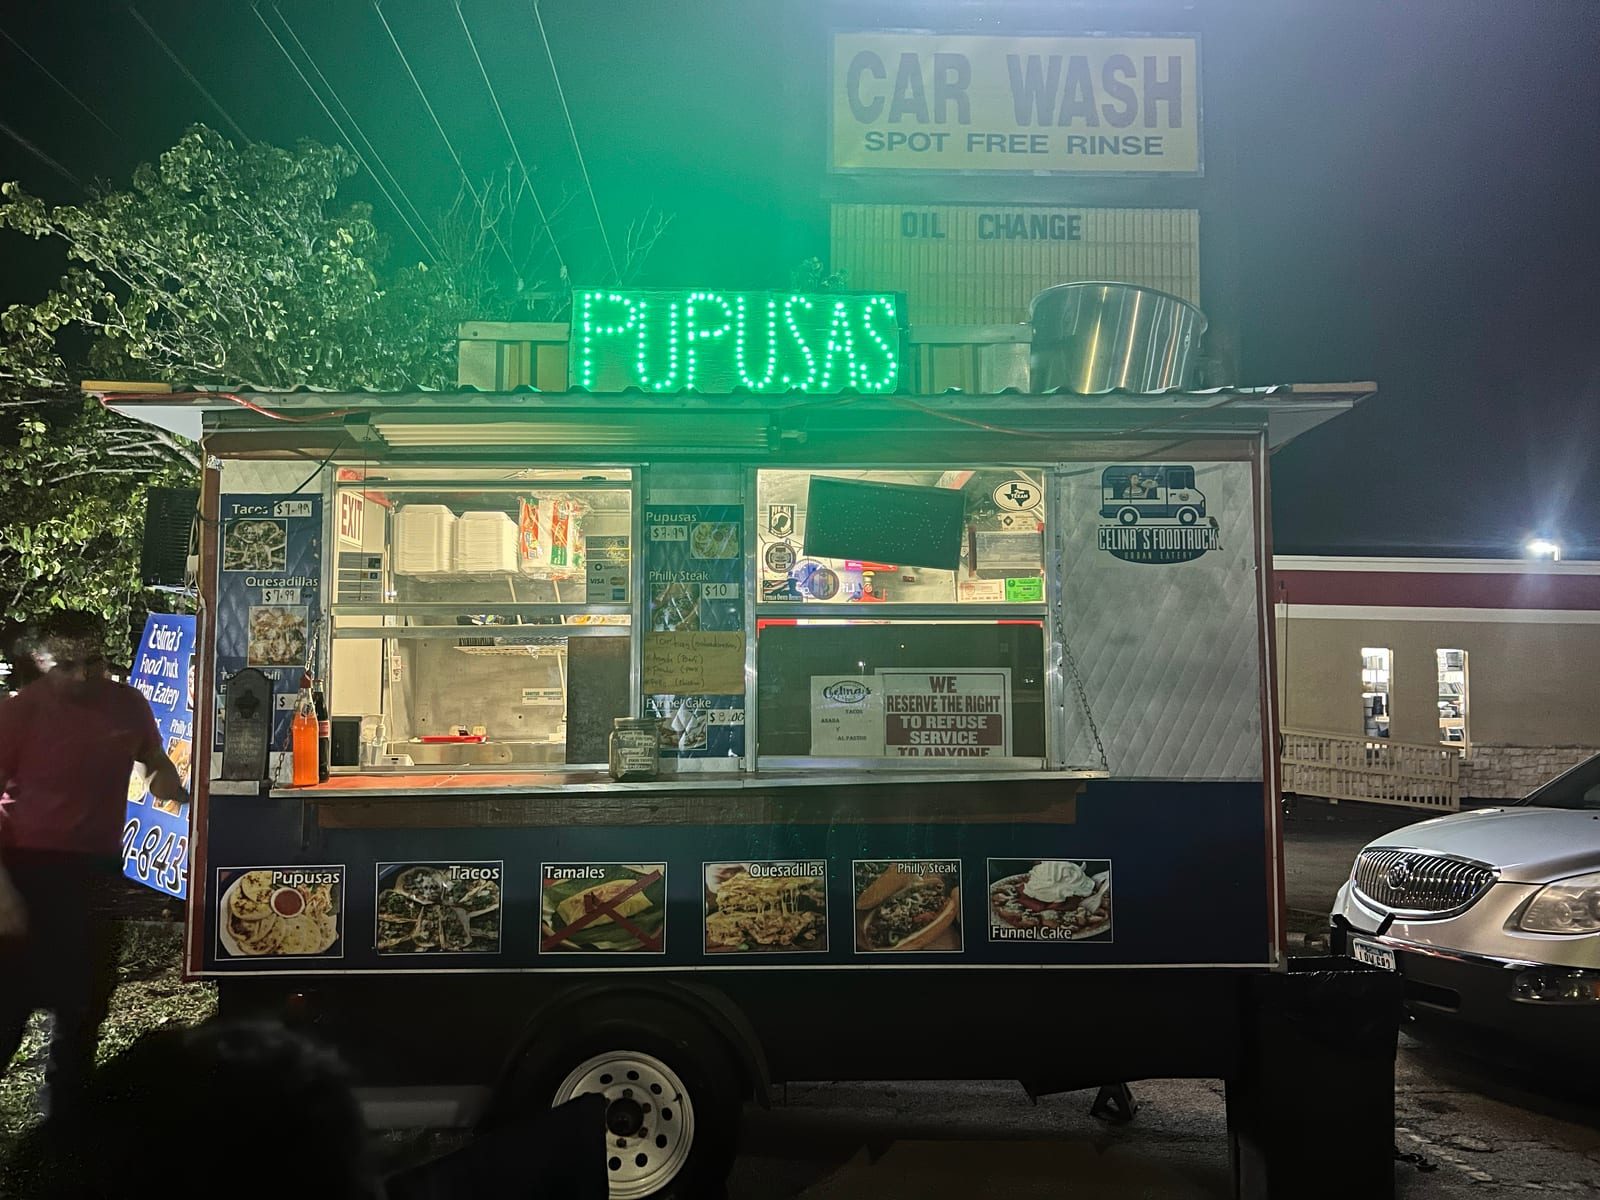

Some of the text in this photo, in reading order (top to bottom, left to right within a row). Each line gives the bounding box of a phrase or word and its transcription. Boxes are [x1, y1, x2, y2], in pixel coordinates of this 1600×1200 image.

[846, 51, 1182, 128] CAR WASH
[865, 131, 1164, 156] SPOT FREE RINSE
[902, 212, 1082, 241] OIL CHANGE
[583, 292, 897, 390] PUPUSAS
[232, 504, 269, 514] Tacos
[342, 493, 362, 541] EXIT
[646, 512, 697, 524] Pupusas
[245, 577, 318, 588] Quesadillas
[649, 571, 709, 582] Philly Steak
[705, 584, 727, 596] $10
[140, 653, 179, 679] Food Truck
[929, 676, 957, 693] WE
[152, 682, 180, 712] Eatery
[686, 698, 711, 708] Cake
[887, 695, 1000, 713] RESERVE THE RIGHT
[900, 716, 987, 729] TO REFUSE
[910, 731, 978, 744] SERVICE
[898, 747, 990, 756] TO ANYONE
[449, 866, 500, 880] Tacos
[544, 866, 605, 879] Tamales
[750, 863, 824, 877] Quesadillas
[897, 863, 957, 876] Philly Steak
[272, 872, 340, 888] Pupusas
[992, 926, 1072, 939] Funnel Cake
